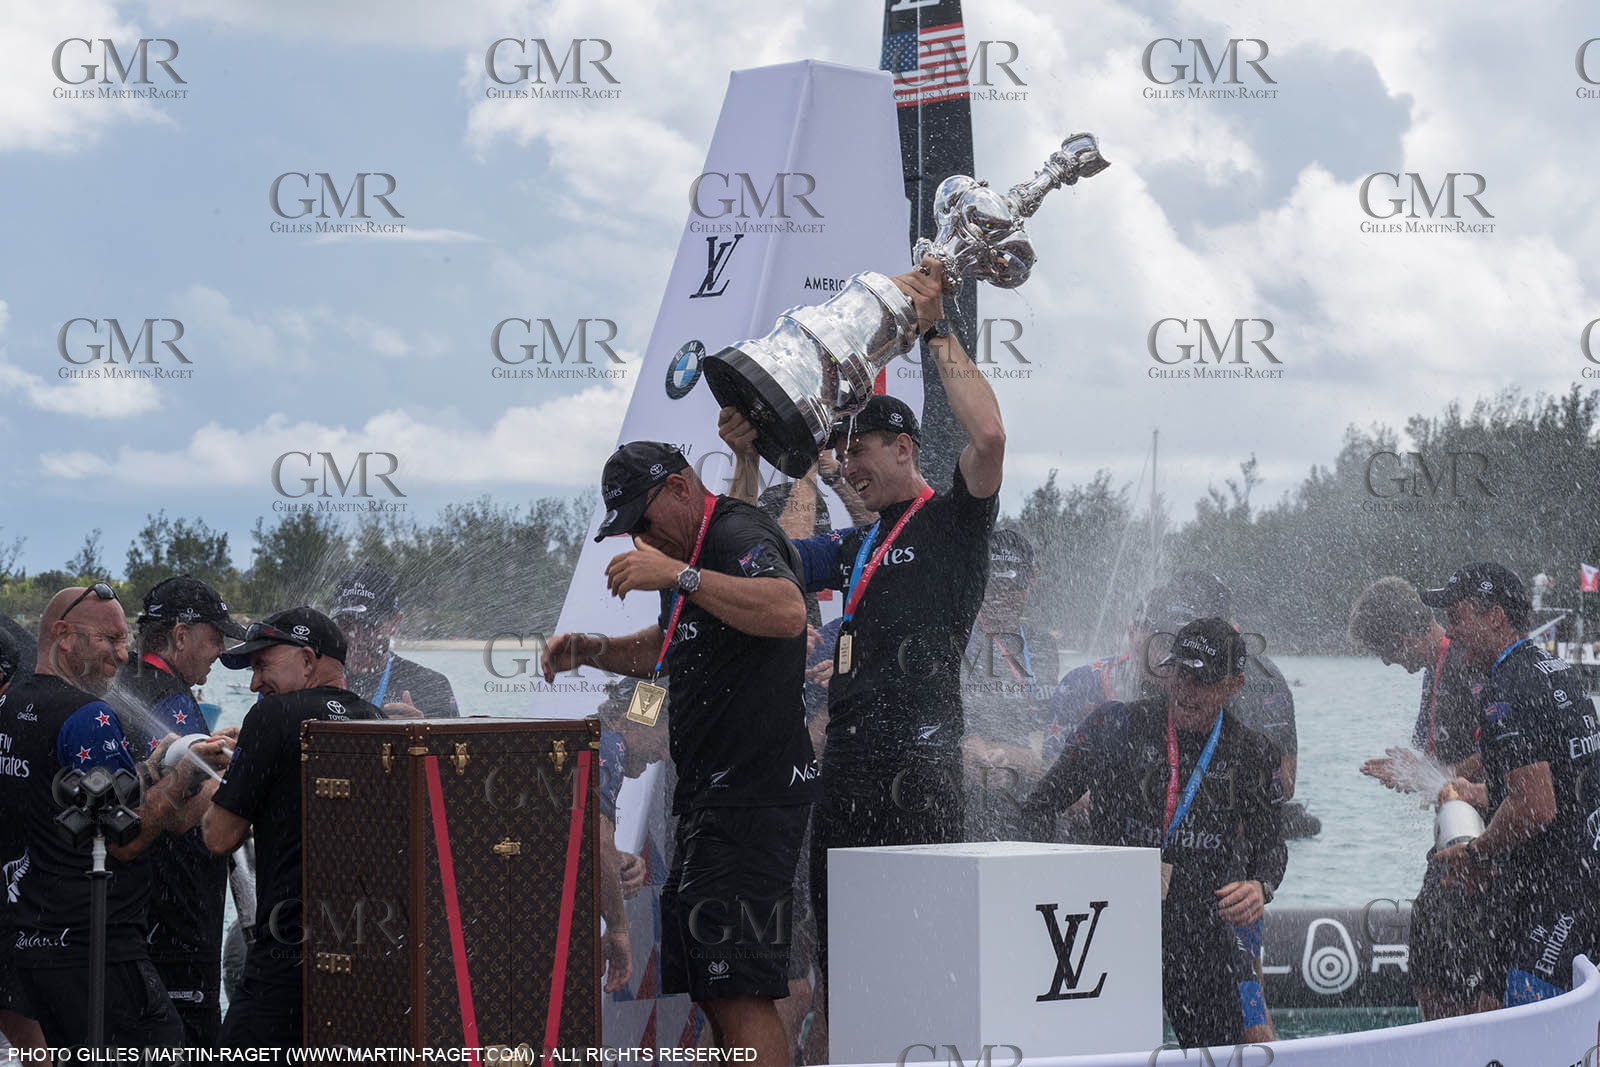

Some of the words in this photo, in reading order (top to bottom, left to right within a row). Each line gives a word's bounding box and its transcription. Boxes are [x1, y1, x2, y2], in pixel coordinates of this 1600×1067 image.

[343, 588, 376, 600] Emirates
[1183, 638, 1217, 656] Emirates
[17, 712, 38, 722] OMEGA
[1530, 923, 1549, 944] Fly
[1535, 912, 1576, 976] Emirates
